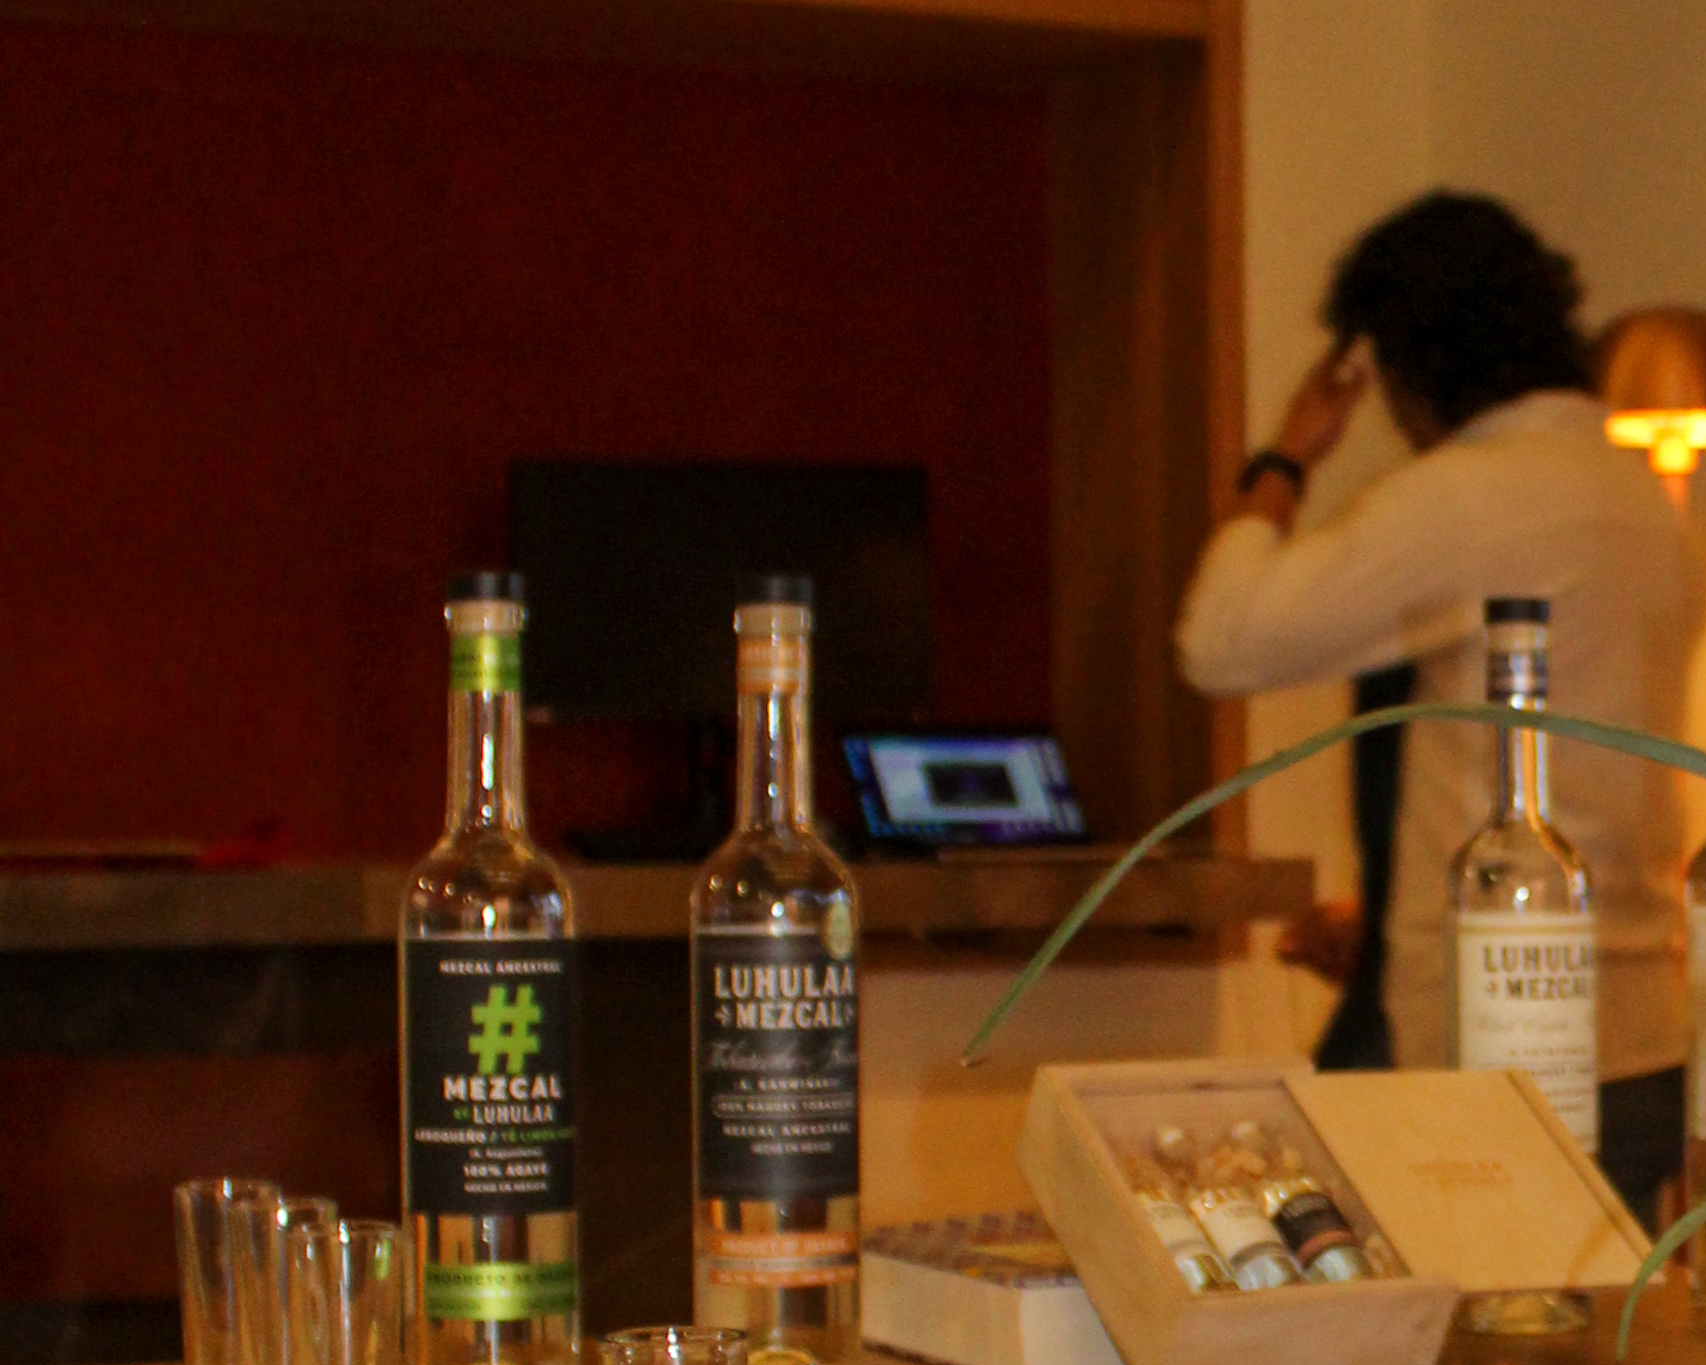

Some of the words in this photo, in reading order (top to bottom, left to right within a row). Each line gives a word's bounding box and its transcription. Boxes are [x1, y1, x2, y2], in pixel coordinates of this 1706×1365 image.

[714, 965, 853, 1000] LUHULAA
[735, 1000, 844, 1029] MEZCAL
[468, 984, 541, 1075] #
[442, 1075, 562, 1101] MEZCAL
[472, 1104, 554, 1125] LUHULAA
[505, 1160, 548, 1178] AGAVE
